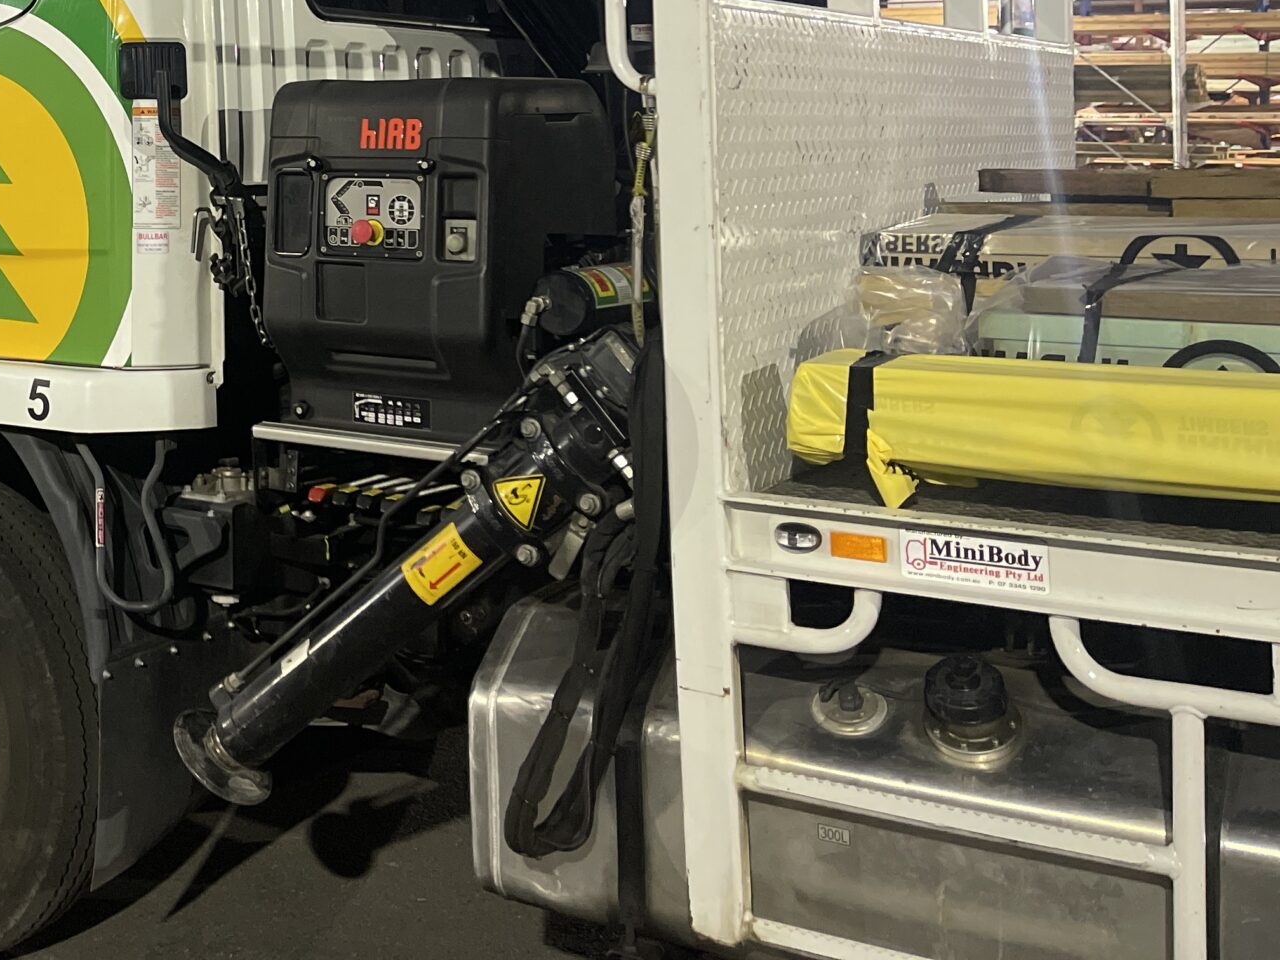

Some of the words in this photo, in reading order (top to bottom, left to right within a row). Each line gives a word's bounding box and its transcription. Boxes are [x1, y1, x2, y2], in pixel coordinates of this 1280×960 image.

[137, 232, 169, 240] BULLBAR
[27, 377, 51, 422] 5
[928, 537, 1044, 571] MiniBody
[939, 560, 1001, 579] Engineering
[1005, 567, 1023, 581] Pty
[1027, 571, 1044, 582] Ltd
[820, 826, 848, 844] 300L
